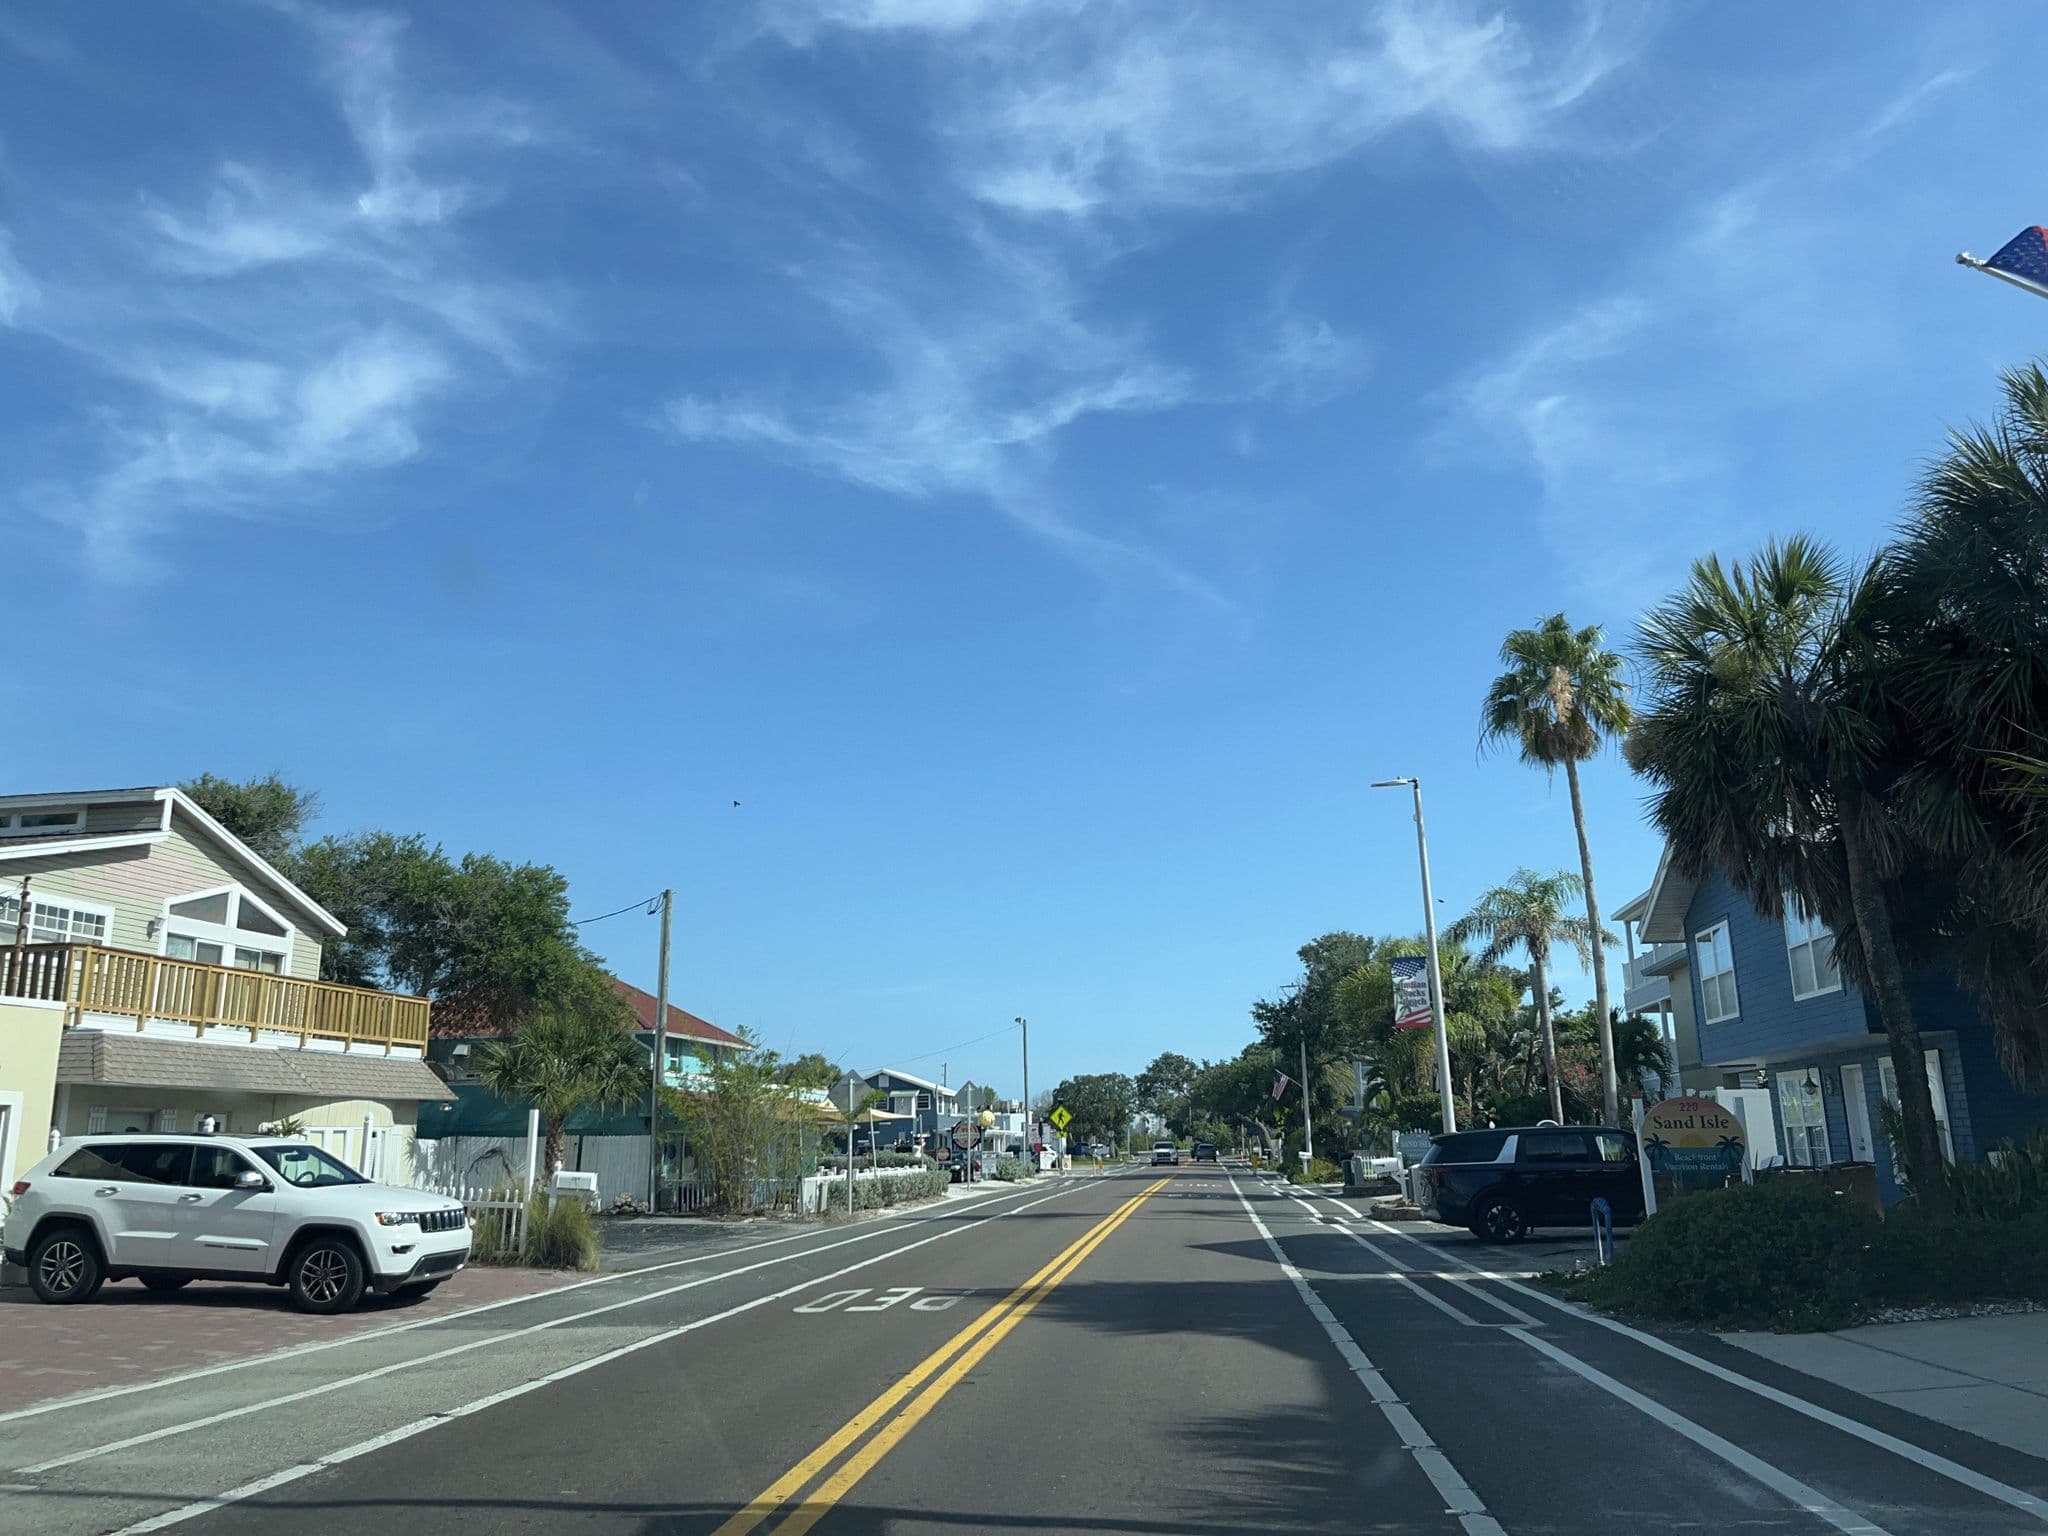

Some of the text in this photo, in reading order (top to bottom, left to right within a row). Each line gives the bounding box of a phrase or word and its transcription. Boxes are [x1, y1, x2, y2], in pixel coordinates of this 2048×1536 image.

[1679, 1102, 1699, 1112] 220
[1653, 1114, 1730, 1130] Sand Isle
[1664, 1161, 1698, 1171] Vacation
[792, 1286, 966, 1313] PED
